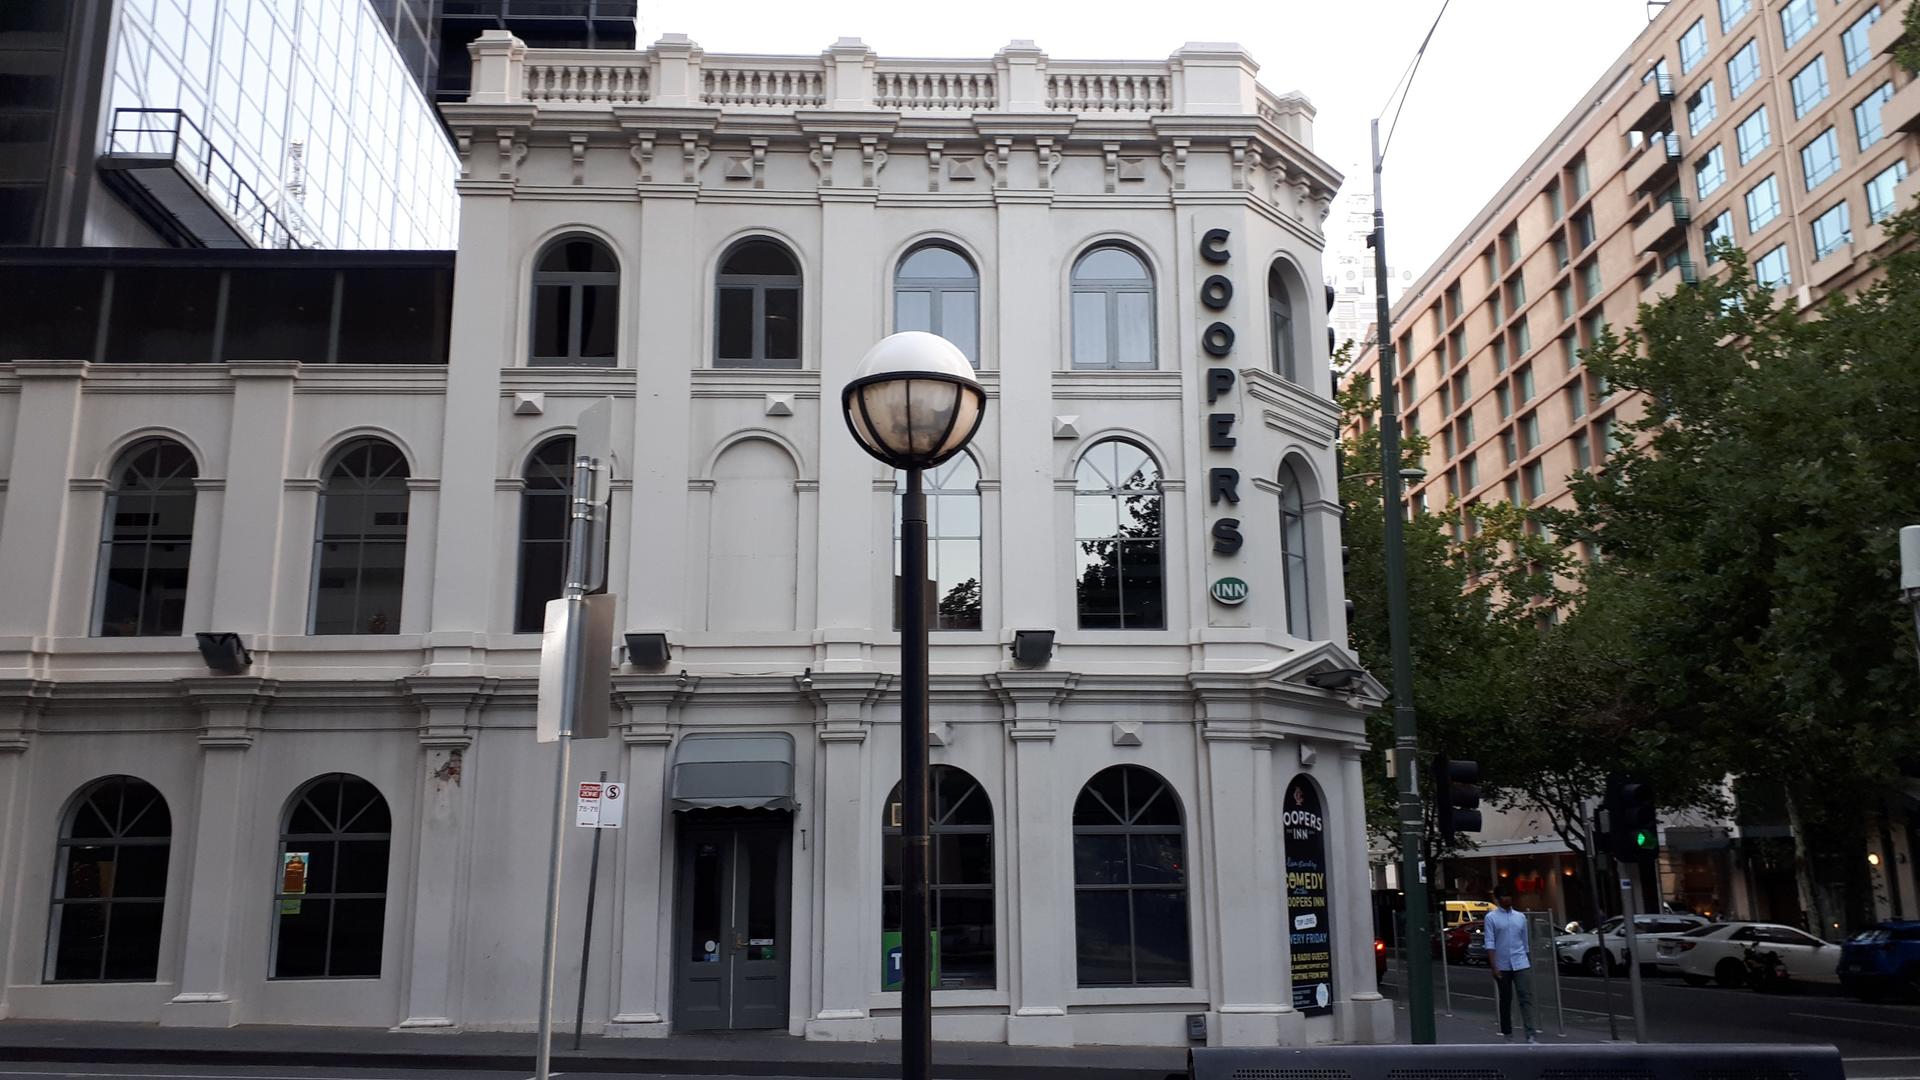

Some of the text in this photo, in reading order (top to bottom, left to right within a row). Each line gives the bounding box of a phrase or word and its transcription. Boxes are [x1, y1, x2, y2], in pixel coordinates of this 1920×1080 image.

[1200, 228, 1243, 556] COOPERS
[1215, 583, 1246, 597] INN
[1283, 810, 1323, 831] OOPERS
[1293, 828, 1308, 840] INN
[1288, 896, 1325, 908] OOPERS INN
[1290, 932, 1328, 945] VERY FRIDAY
